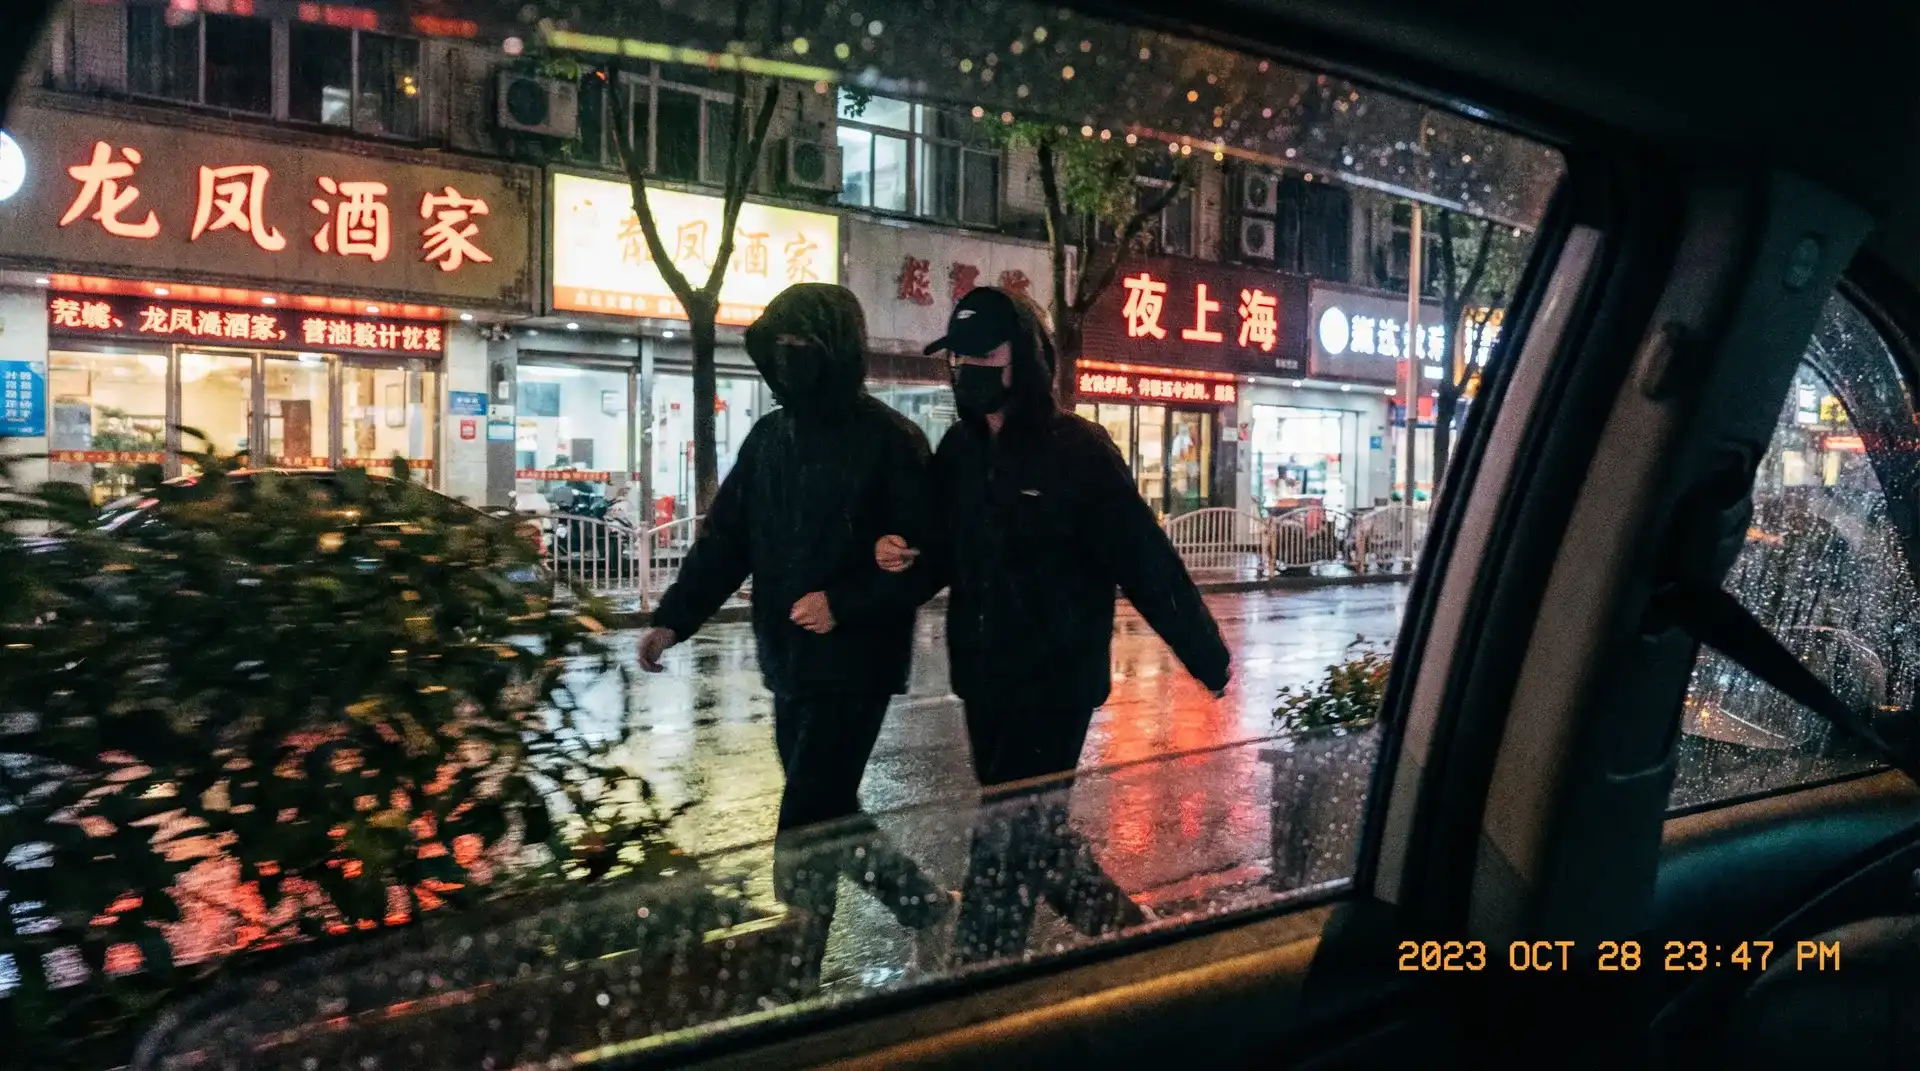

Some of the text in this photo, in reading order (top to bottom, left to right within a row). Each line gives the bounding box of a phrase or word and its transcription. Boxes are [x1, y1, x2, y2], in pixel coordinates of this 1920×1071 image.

[60, 140, 493, 273] 龙凤酒家
[1122, 272, 1277, 351] 夜上海
